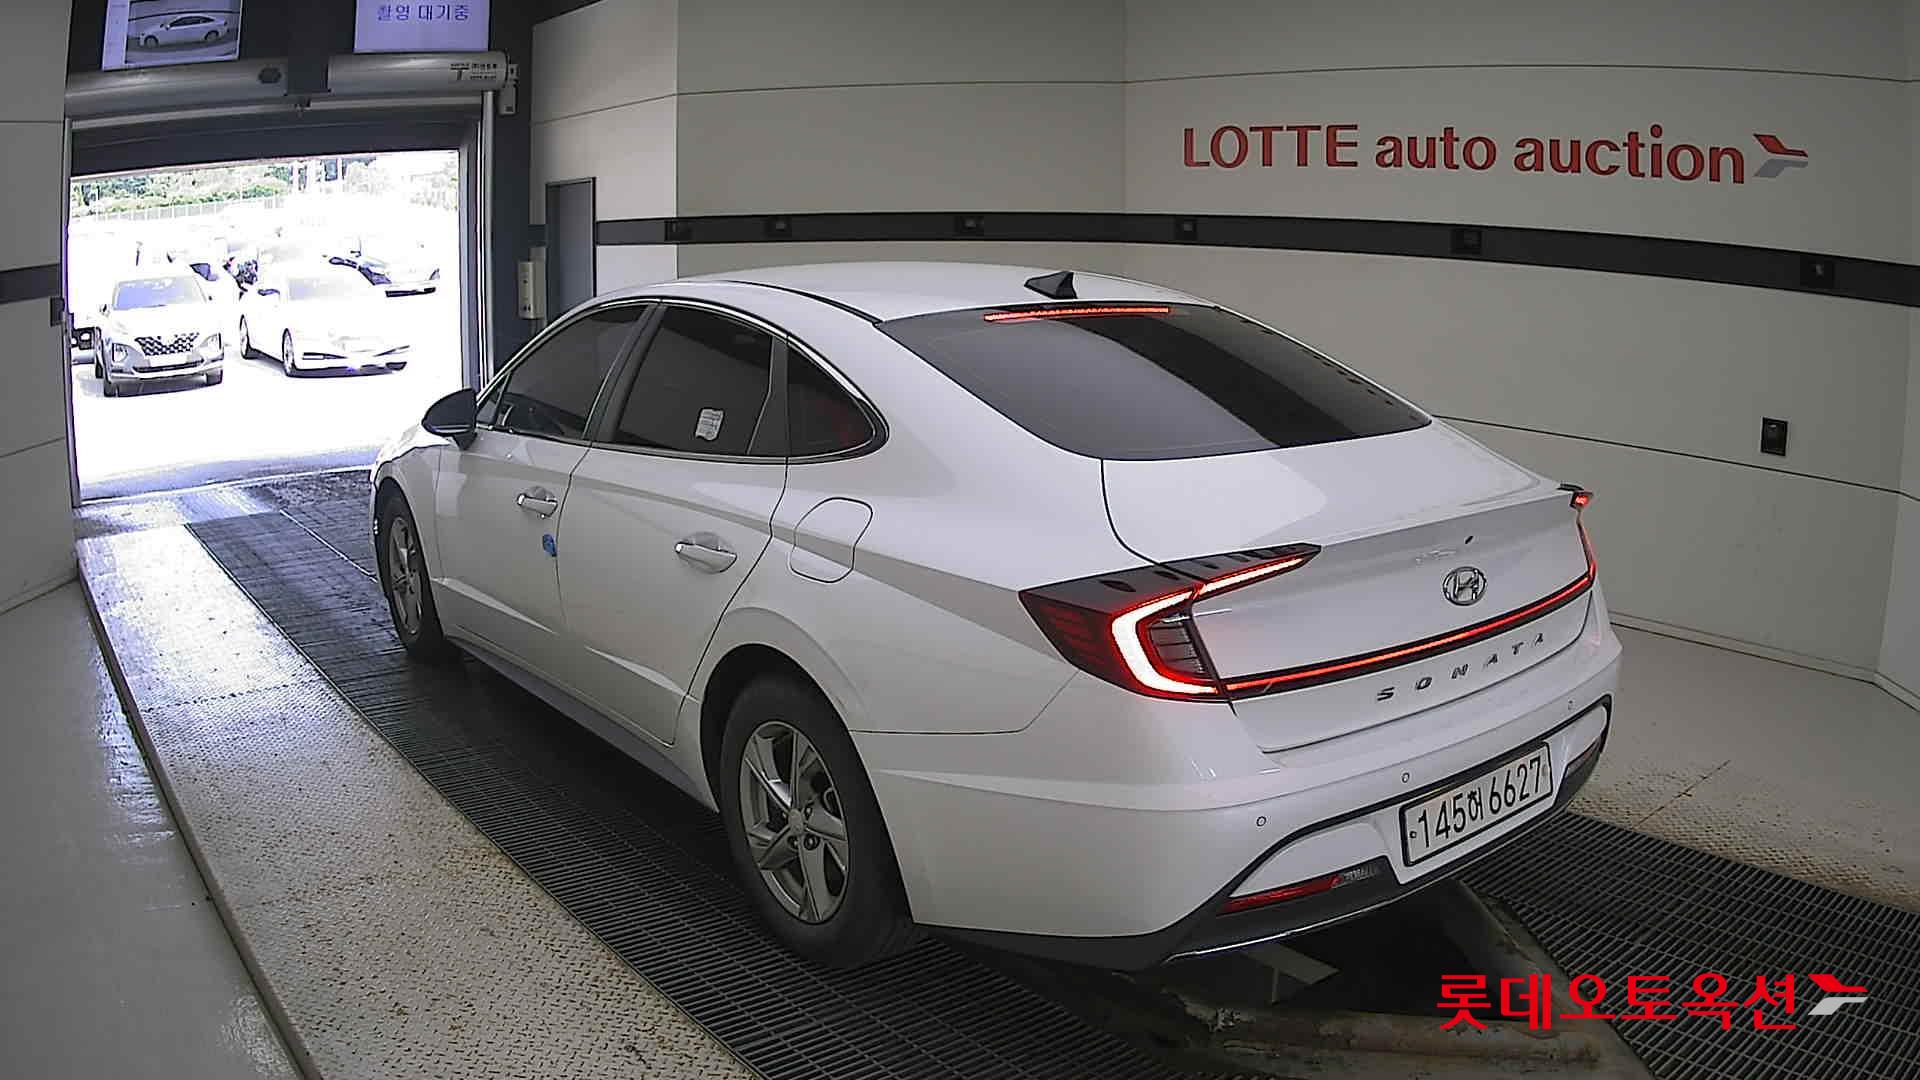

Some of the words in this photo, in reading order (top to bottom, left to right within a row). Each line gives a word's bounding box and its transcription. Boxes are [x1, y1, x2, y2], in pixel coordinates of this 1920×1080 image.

[418, 4, 470, 21] 대기중
[1183, 124, 1359, 169] LOTTE
[1375, 126, 1496, 170] auto
[1513, 123, 1745, 184] auction
[1376, 632, 1545, 702] SONATA
[1488, 755, 1542, 815] 6627
